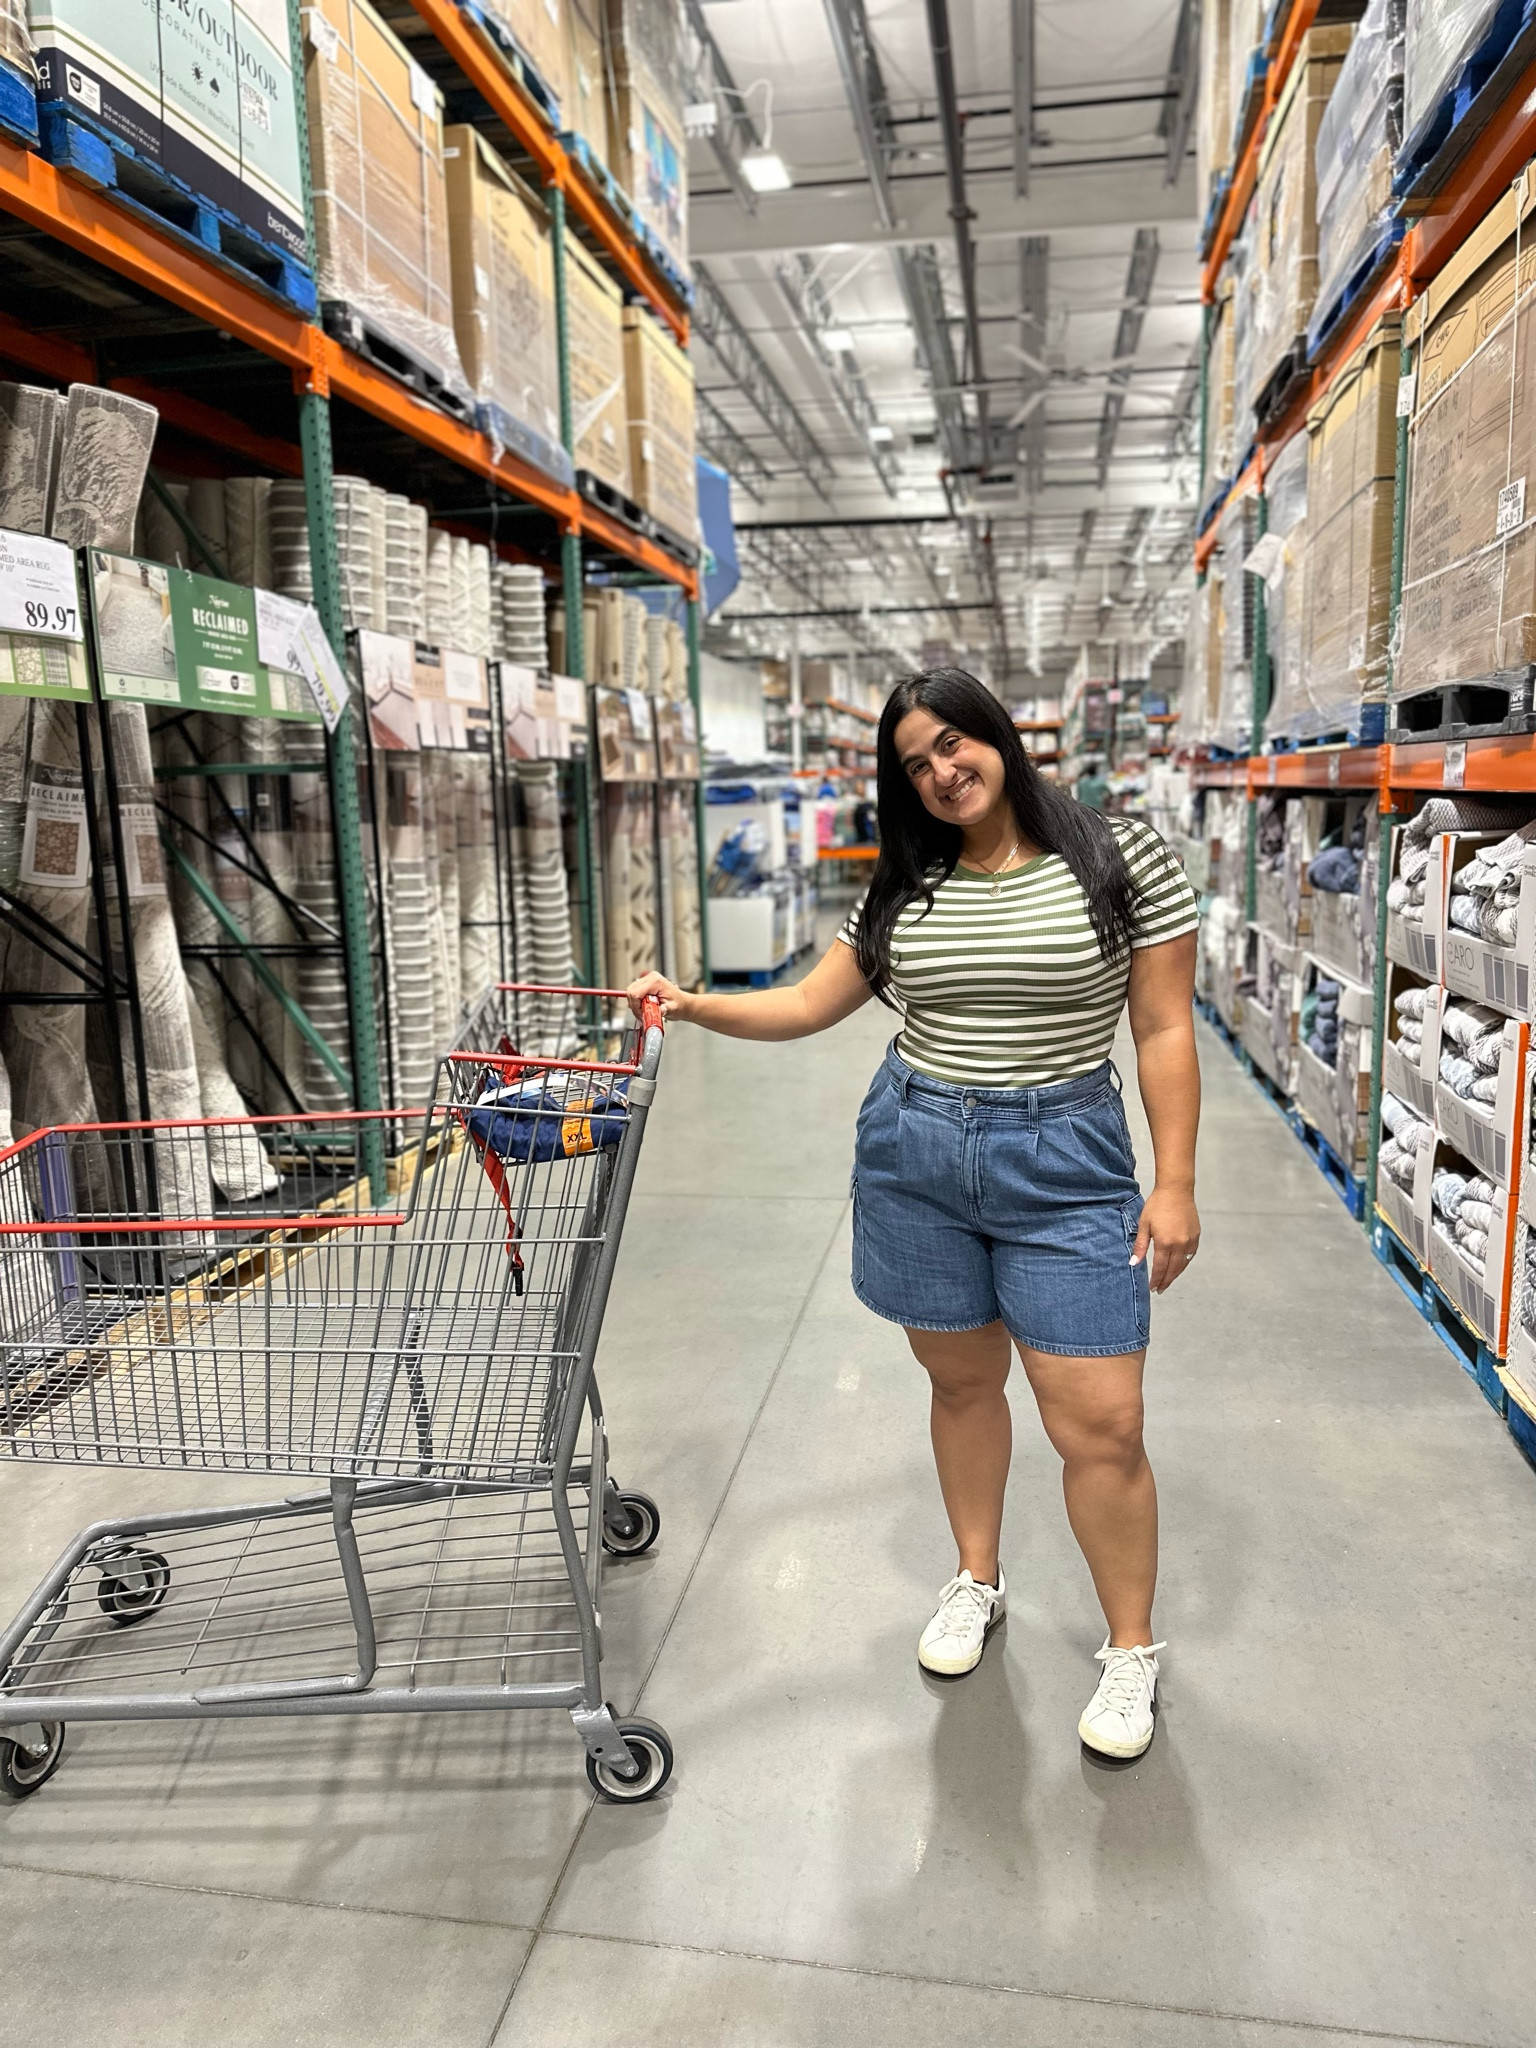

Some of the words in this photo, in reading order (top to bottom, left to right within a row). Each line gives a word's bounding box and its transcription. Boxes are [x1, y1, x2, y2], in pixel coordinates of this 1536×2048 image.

[25, 601, 76, 632] 89.97
[192, 607, 249, 636] RECLAIMED
[567, 1131, 587, 1143] XXL
